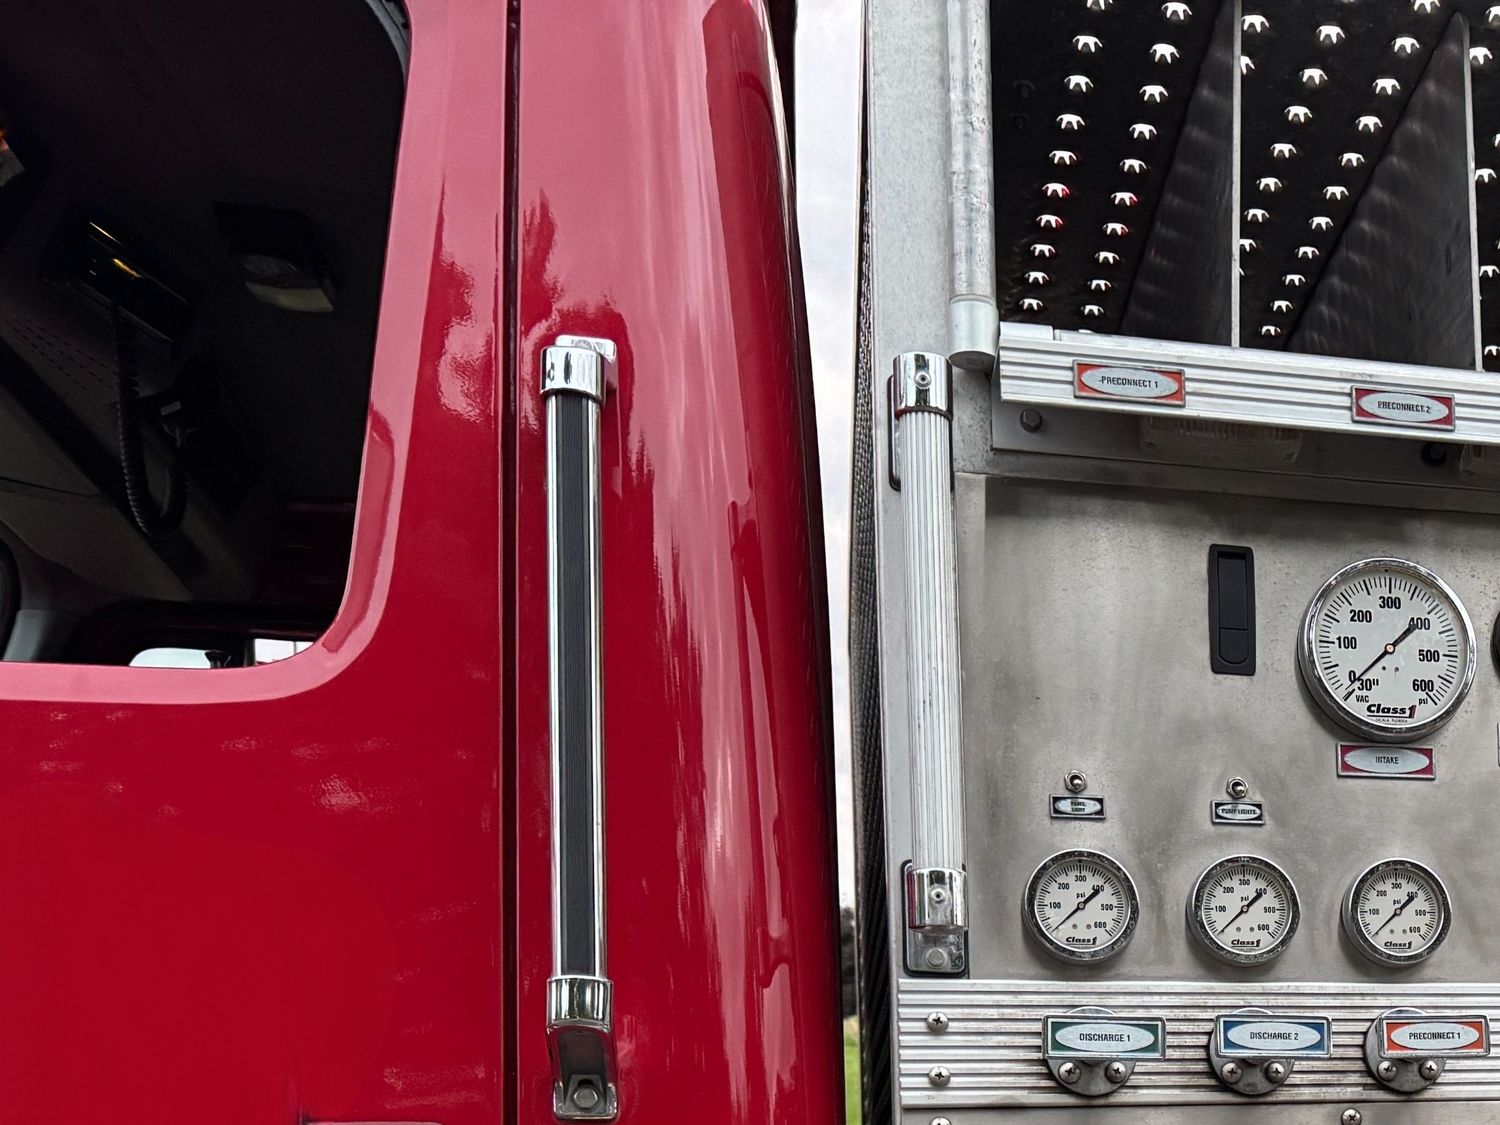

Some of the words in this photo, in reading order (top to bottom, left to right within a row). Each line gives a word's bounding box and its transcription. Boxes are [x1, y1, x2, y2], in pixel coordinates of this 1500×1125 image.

[1101, 376, 1151, 388] PRECONNECT
[1154, 380, 1158, 388] 1
[1377, 400, 1424, 412] PRECONNECT
[1425, 404, 1431, 414] 2
[1379, 596, 1402, 610] 300
[1350, 610, 1372, 624] 200
[1408, 617, 1430, 630] 400
[1336, 636, 1357, 650] 100
[1418, 650, 1440, 662] 500
[1412, 679, 1434, 692] 600
[1355, 694, 1370, 703] VAC
[1418, 697, 1428, 706] psi
[1375, 756, 1399, 764] INTAKE
[1074, 874, 1086, 882] 300
[1238, 878, 1250, 887] 300
[1058, 882, 1070, 890] 200
[1222, 886, 1234, 894] 200
[1391, 882, 1402, 890] 300
[1050, 902, 1062, 910] 100
[1214, 905, 1226, 913] 100
[1264, 906, 1276, 914] 500
[1368, 908, 1380, 916] 100
[1094, 922, 1107, 930] 600
[1258, 924, 1270, 932] 600
[1409, 926, 1420, 934] 600
[1078, 1032, 1124, 1042] DISCHARGE
[1126, 1034, 1131, 1042] 1
[1250, 1031, 1291, 1041] DISCHARGE
[1292, 1032, 1298, 1041] 2
[1408, 1031, 1454, 1041] PRECONNECT
